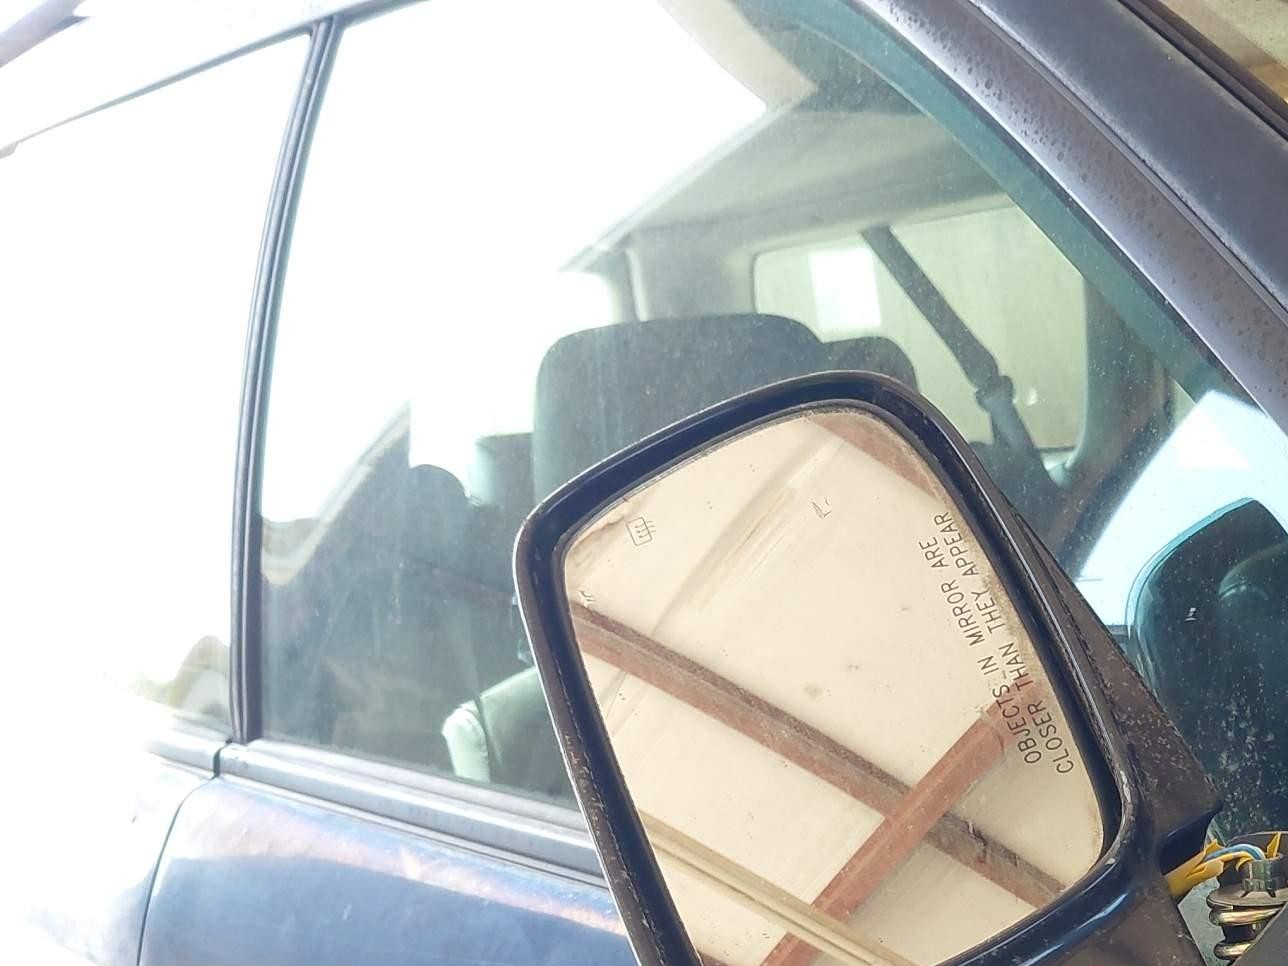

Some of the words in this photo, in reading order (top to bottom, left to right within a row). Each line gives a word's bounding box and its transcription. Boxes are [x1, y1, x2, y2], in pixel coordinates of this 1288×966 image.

[918, 536, 948, 568] ARE
[933, 511, 979, 577] APPEAR
[940, 579, 985, 646] MIRROR
[971, 590, 1005, 635] THEY
[977, 655, 999, 675] IN
[998, 642, 1034, 691] THAN
[992, 684, 1042, 763] OBJECTS
[1027, 700, 1074, 773] CLOSER
